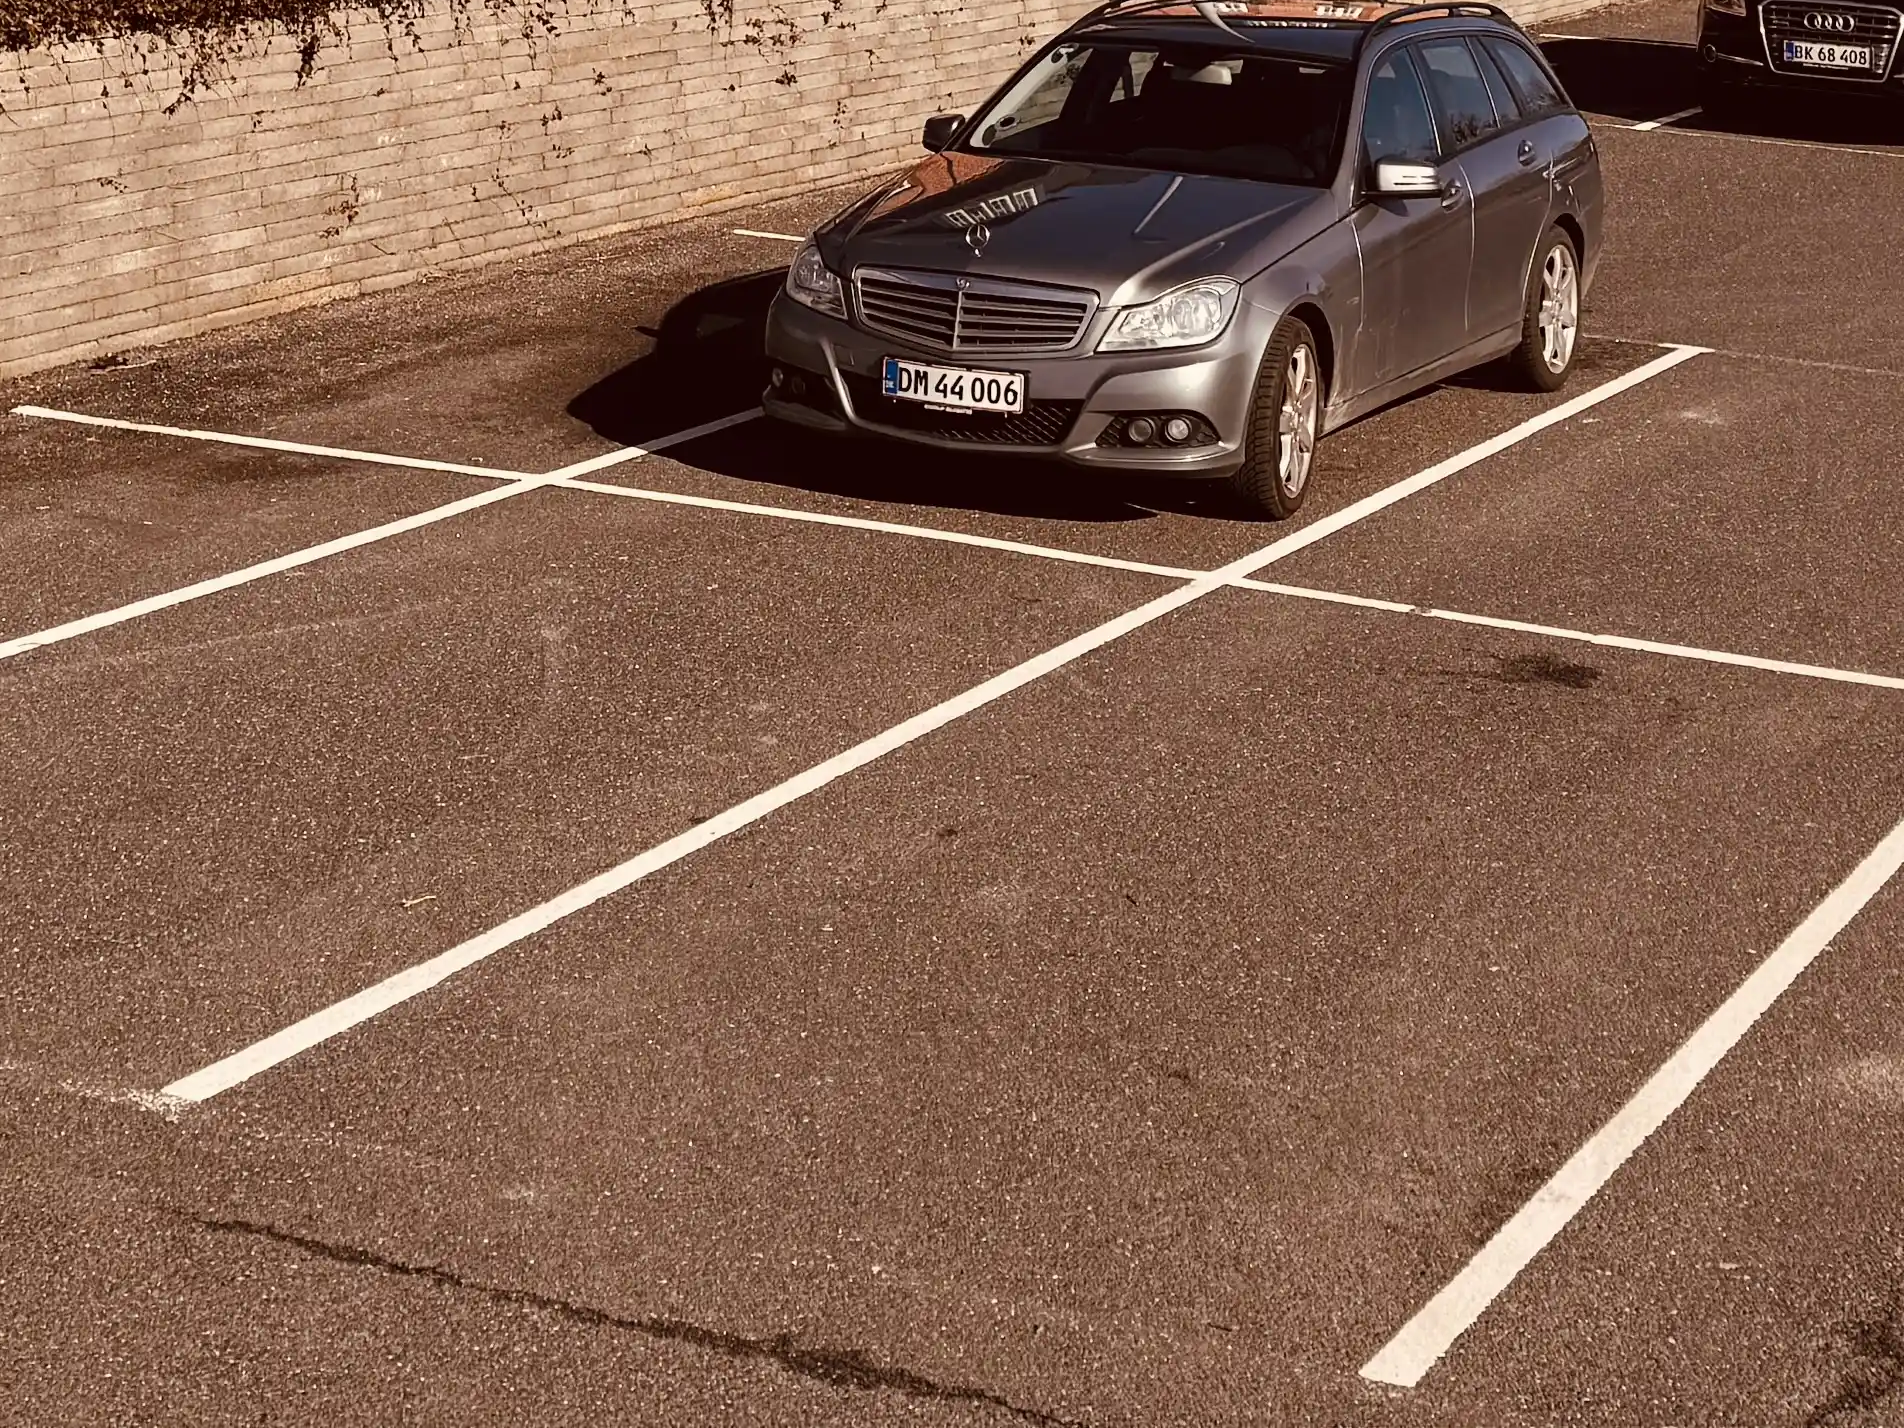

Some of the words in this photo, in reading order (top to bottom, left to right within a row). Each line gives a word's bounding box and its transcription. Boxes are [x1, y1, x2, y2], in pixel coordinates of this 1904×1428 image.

[1794, 45, 1814, 60] BK
[1817, 47, 1836, 62] 68
[1839, 49, 1867, 65] 408
[899, 366, 929, 396] DM
[934, 373, 964, 401] 44
[971, 377, 1018, 406] 006
